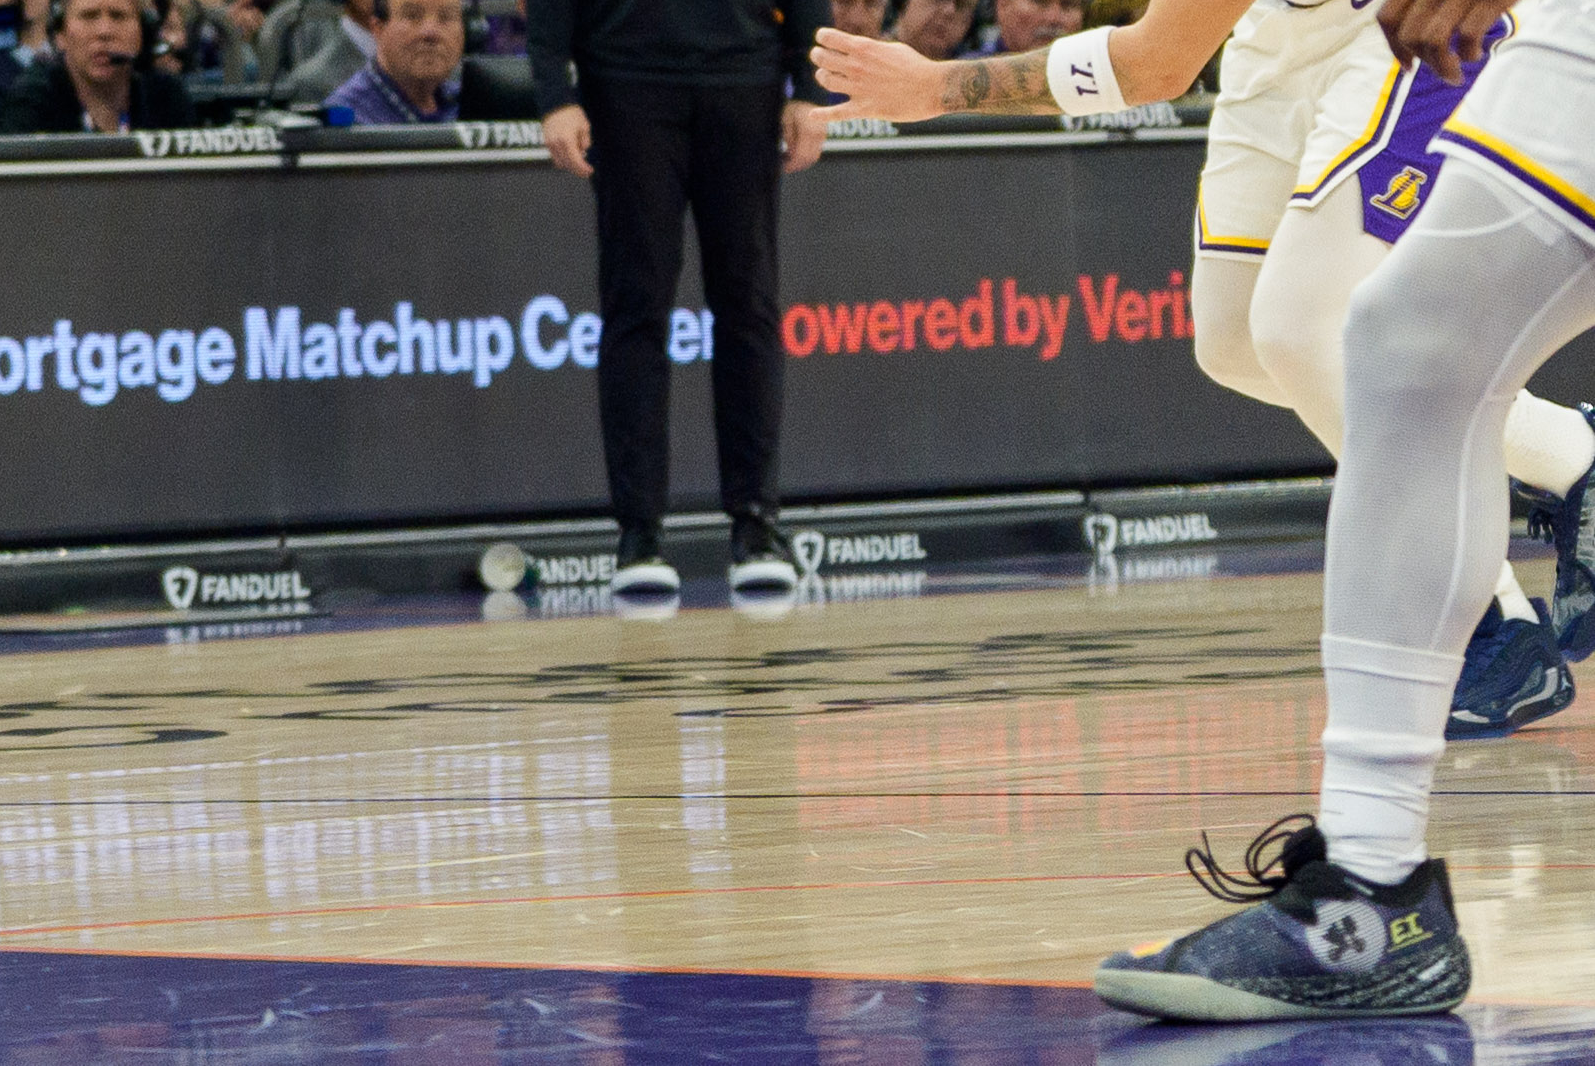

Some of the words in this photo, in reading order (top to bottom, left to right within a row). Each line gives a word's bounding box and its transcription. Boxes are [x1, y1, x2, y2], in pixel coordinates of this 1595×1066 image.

[175, 127, 283, 153] FANDUEL
[827, 118, 899, 137] NDUEL
[780, 278, 995, 357] owered
[1002, 277, 1071, 361] by
[1077, 270, 1195, 343] Veri
[244, 301, 514, 388] Matchup
[521, 294, 714, 370] Ceer
[1120, 513, 1218, 545] FANDUEL
[828, 534, 927, 565] FANDUEL
[526, 553, 618, 585] ANDUE
[200, 571, 311, 602] FANDUEL
